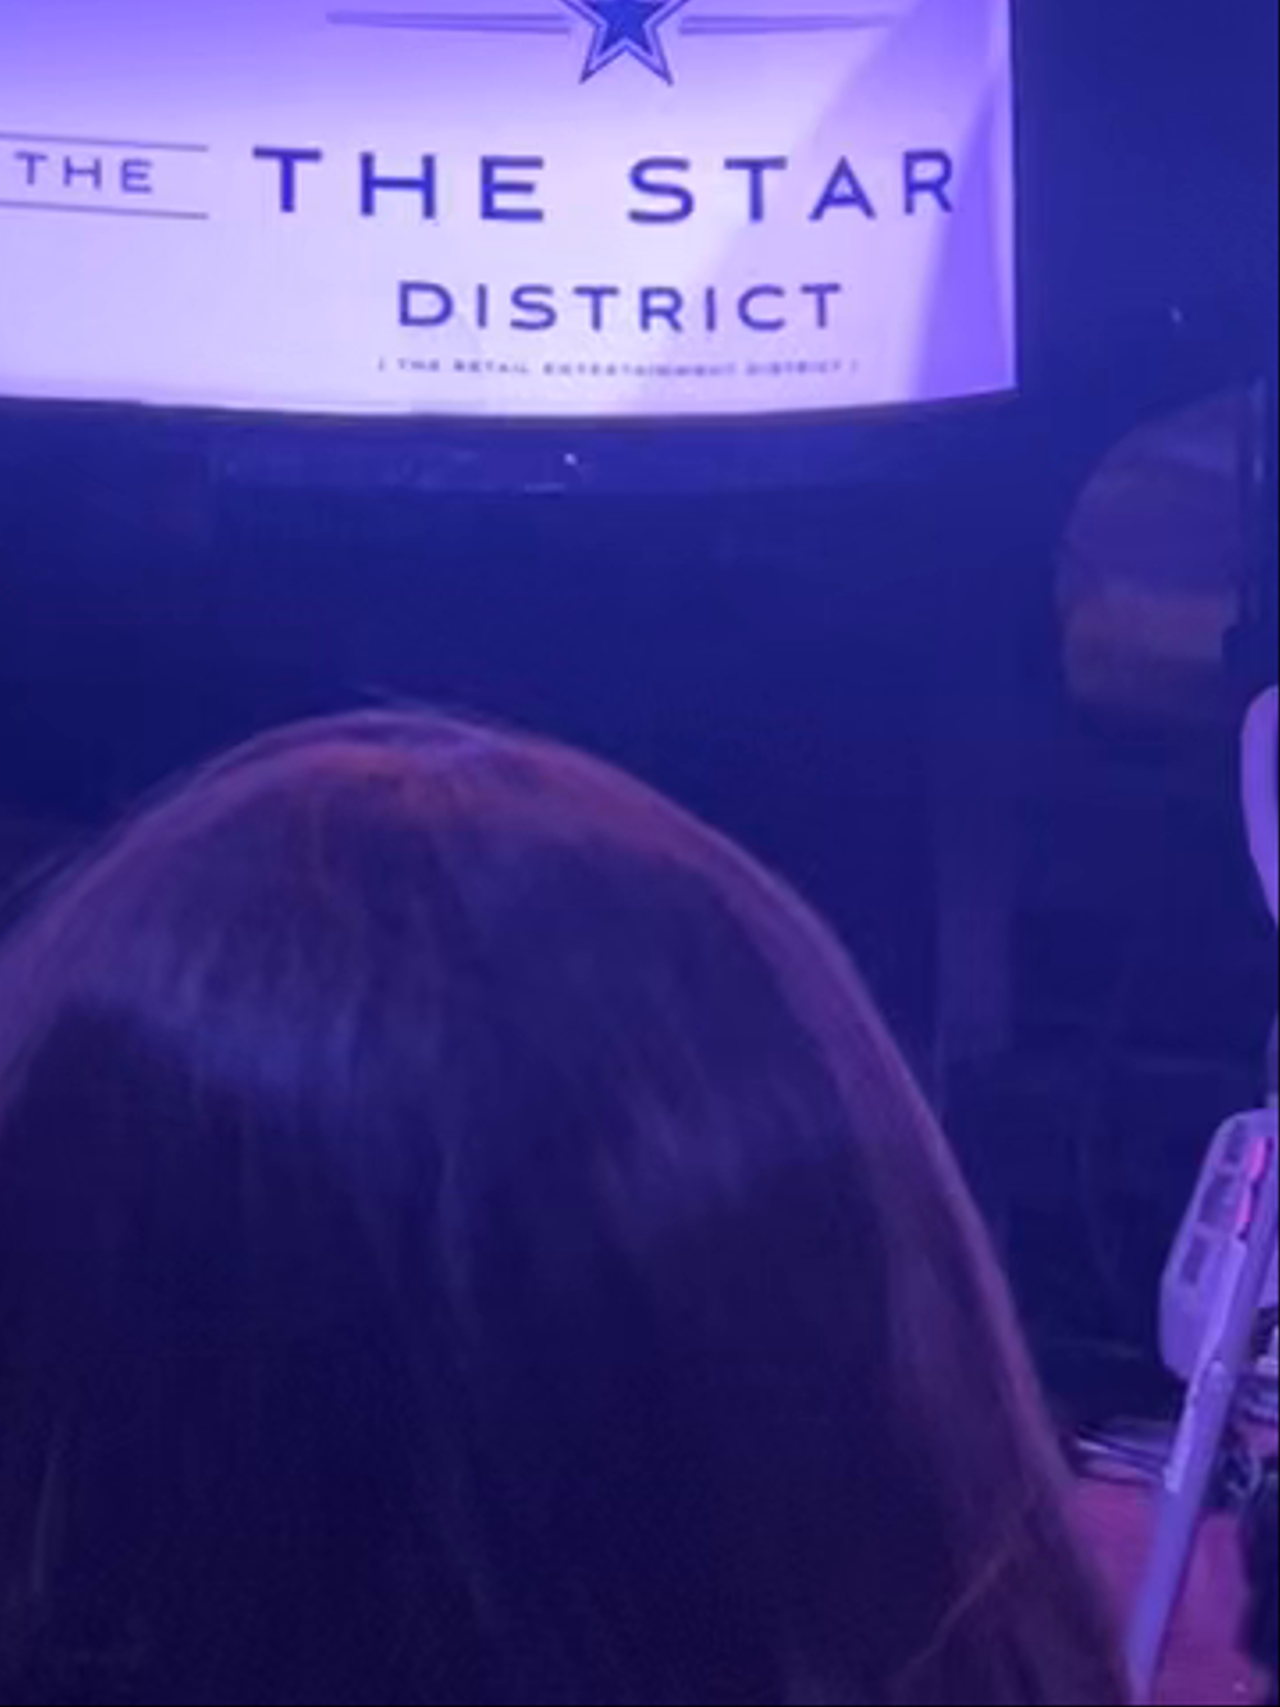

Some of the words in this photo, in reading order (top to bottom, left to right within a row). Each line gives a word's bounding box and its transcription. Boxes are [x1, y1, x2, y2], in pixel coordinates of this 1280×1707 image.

[14, 149, 155, 195] THE
[251, 146, 547, 223] THE
[625, 146, 956, 224] STAR
[397, 279, 843, 334] DISTRICT
